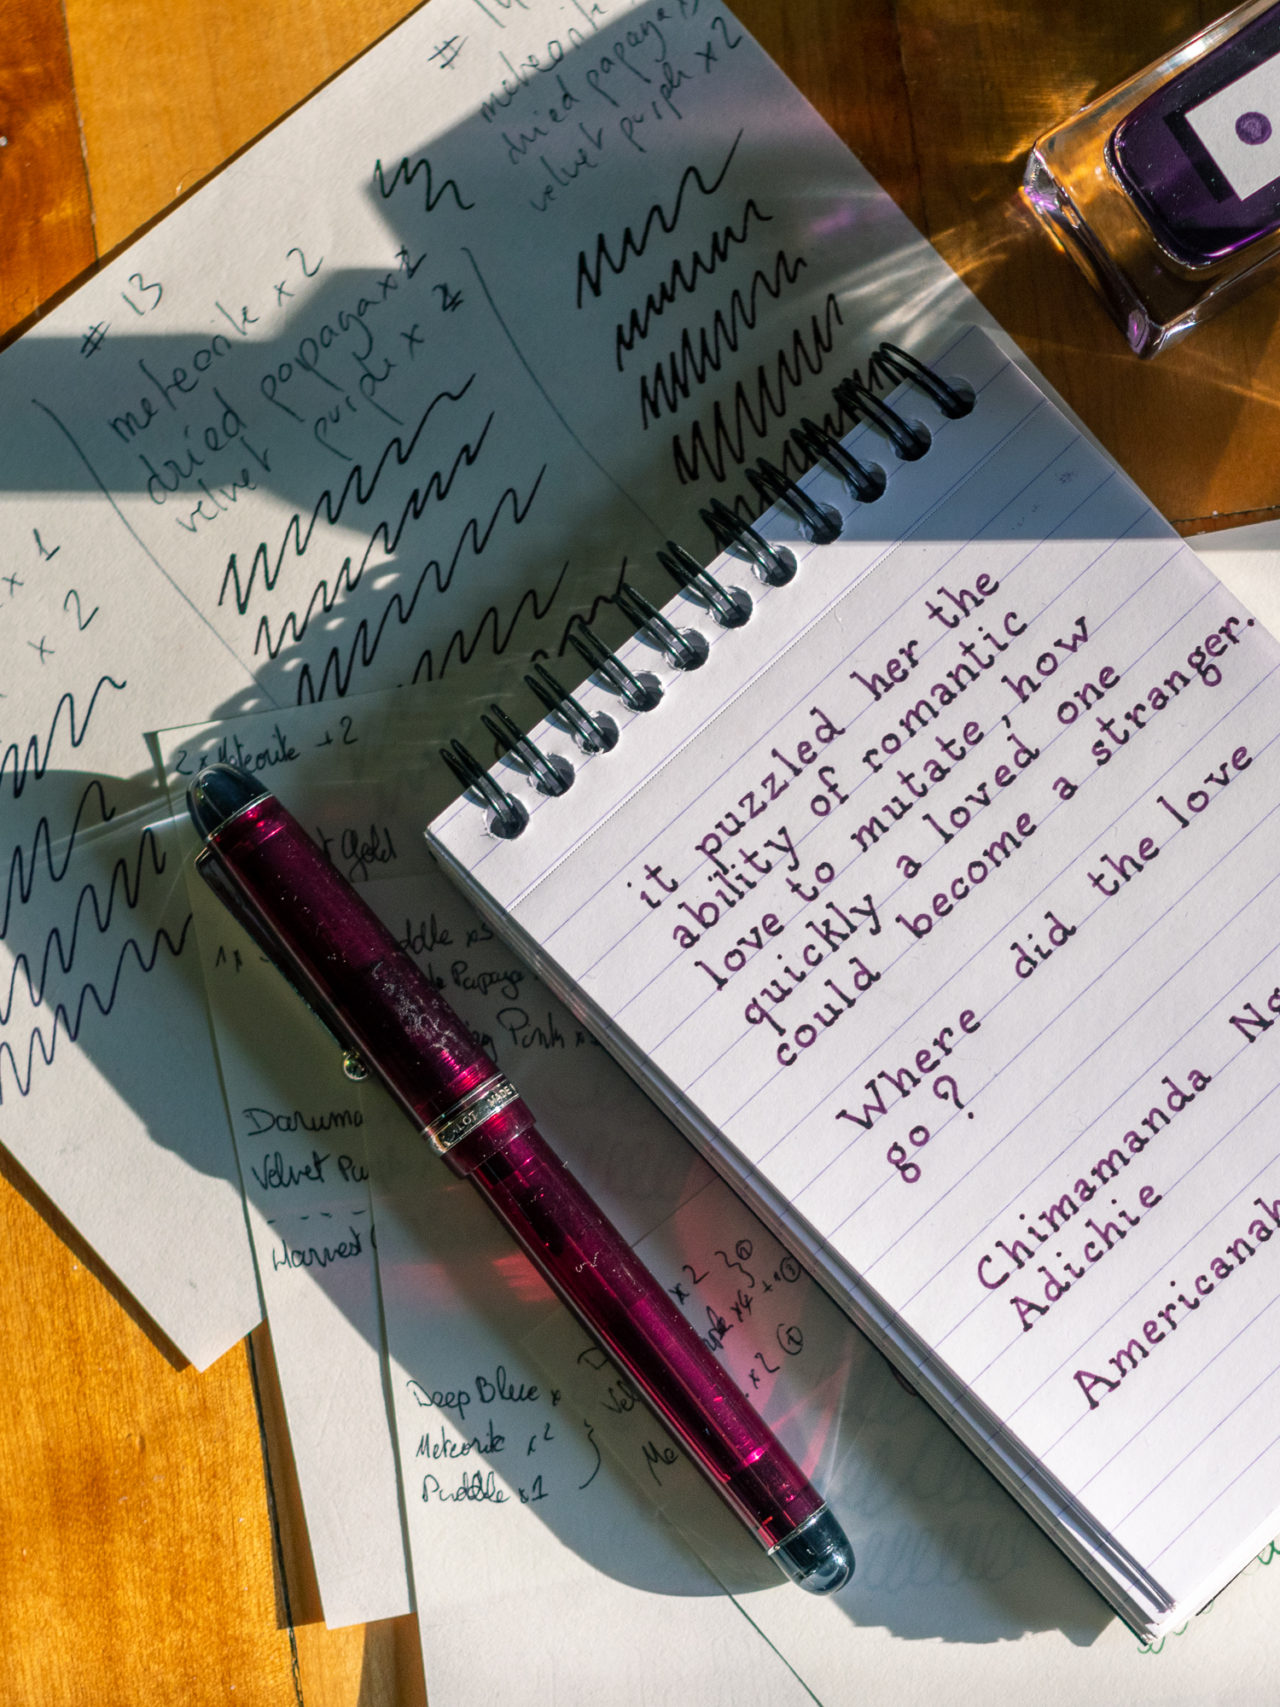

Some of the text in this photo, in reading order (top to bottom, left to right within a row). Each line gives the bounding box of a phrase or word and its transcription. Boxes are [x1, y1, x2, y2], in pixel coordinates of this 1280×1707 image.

[627, 573, 1000, 909] it puzzled her the
[672, 609, 1028, 950] ability of romantic
[694, 912, 785, 990] love
[785, 862, 835, 904] to
[1001, 615, 1089, 704] how
[744, 665, 1121, 1036] quickly a loved one
[776, 616, 1255, 1067] could become a stranger.
[835, 743, 1254, 1130] Where did the love
[977, 1068, 1211, 1289] Chimamanda
[1010, 1185, 1162, 1332] Adichie
